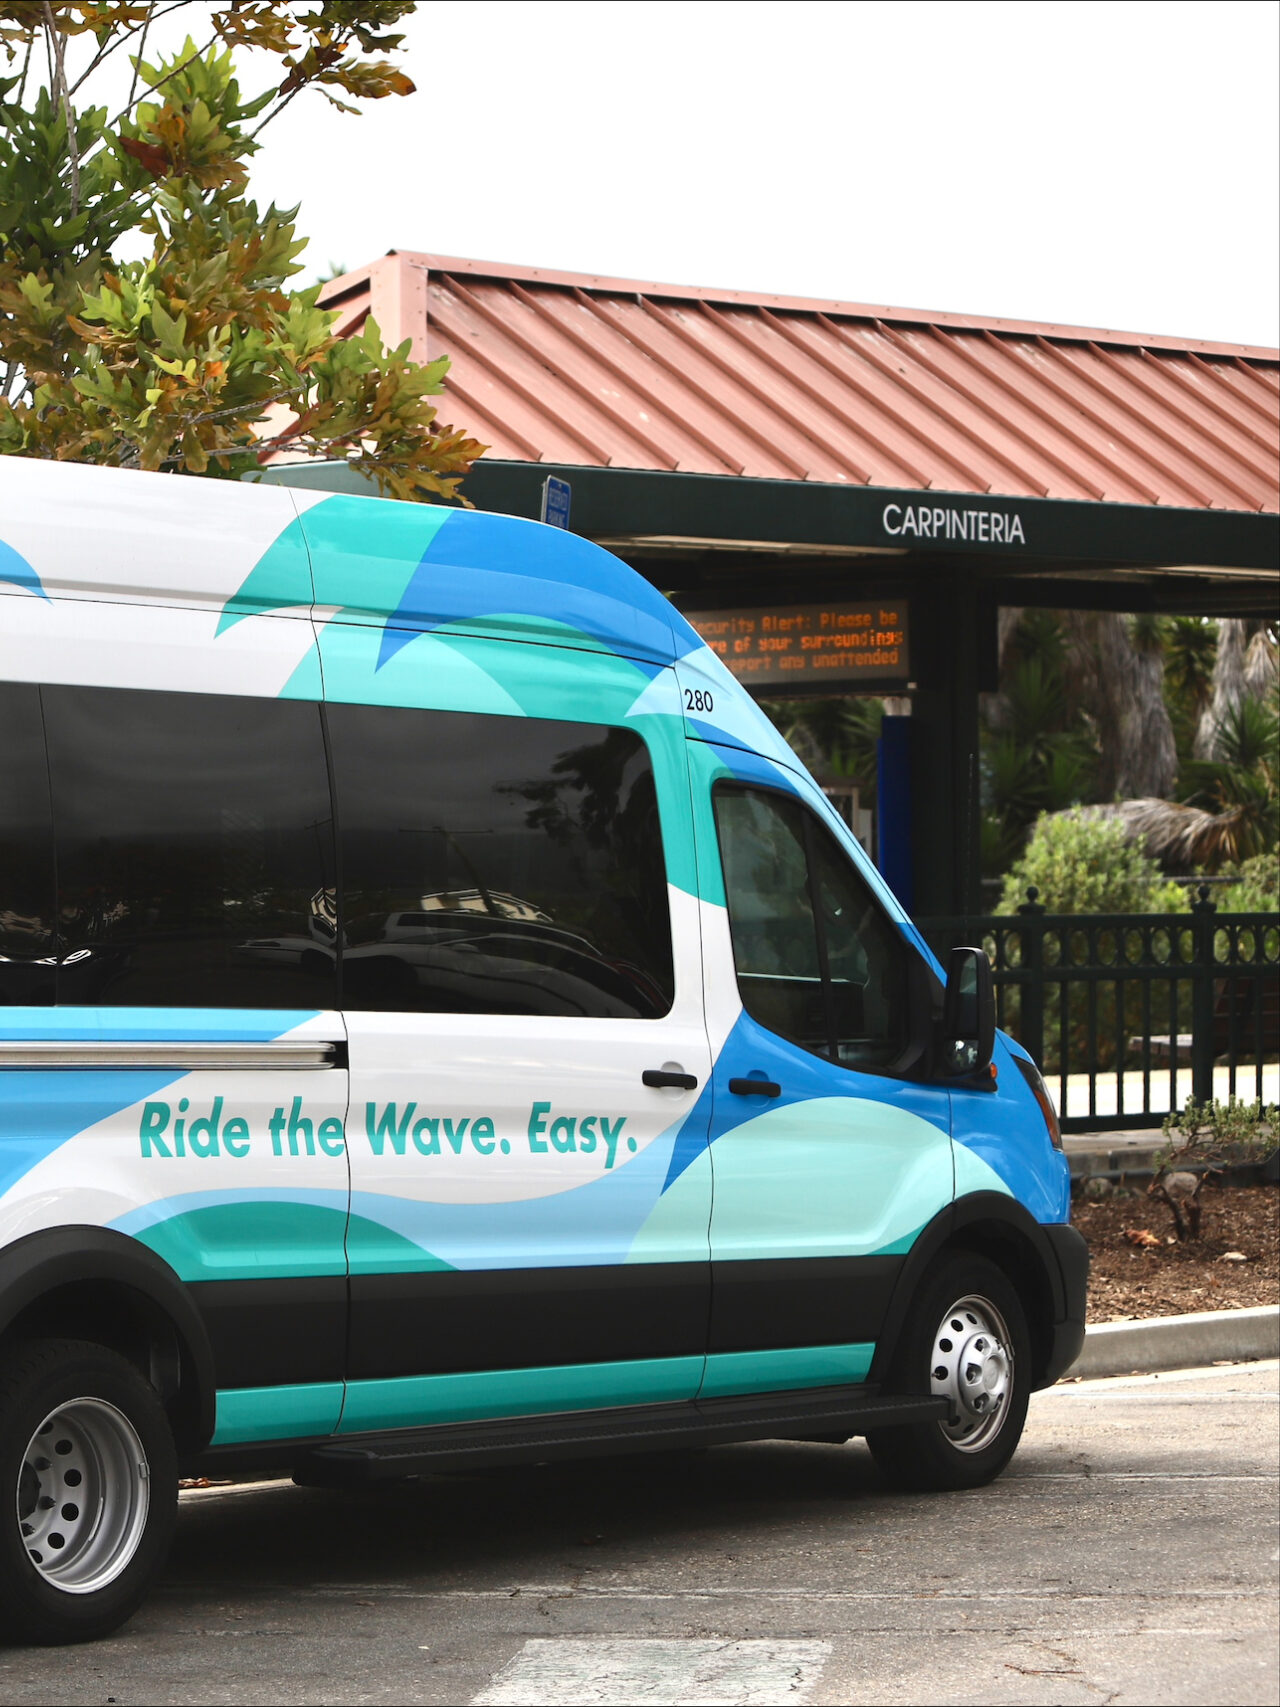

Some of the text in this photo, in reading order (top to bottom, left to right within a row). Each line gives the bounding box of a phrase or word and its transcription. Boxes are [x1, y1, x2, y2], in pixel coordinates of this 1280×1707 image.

[882, 503, 1026, 544] CARPINTERIA
[762, 614, 811, 631] Alert:
[820, 612, 872, 628] Please
[879, 609, 898, 626] be
[734, 636, 751, 653] of
[759, 637, 792, 652] your
[779, 655, 806, 670] any
[812, 647, 898, 668] unattended
[684, 688, 713, 712] 280
[138, 1095, 638, 1169] Ride the Wave. Easy.
